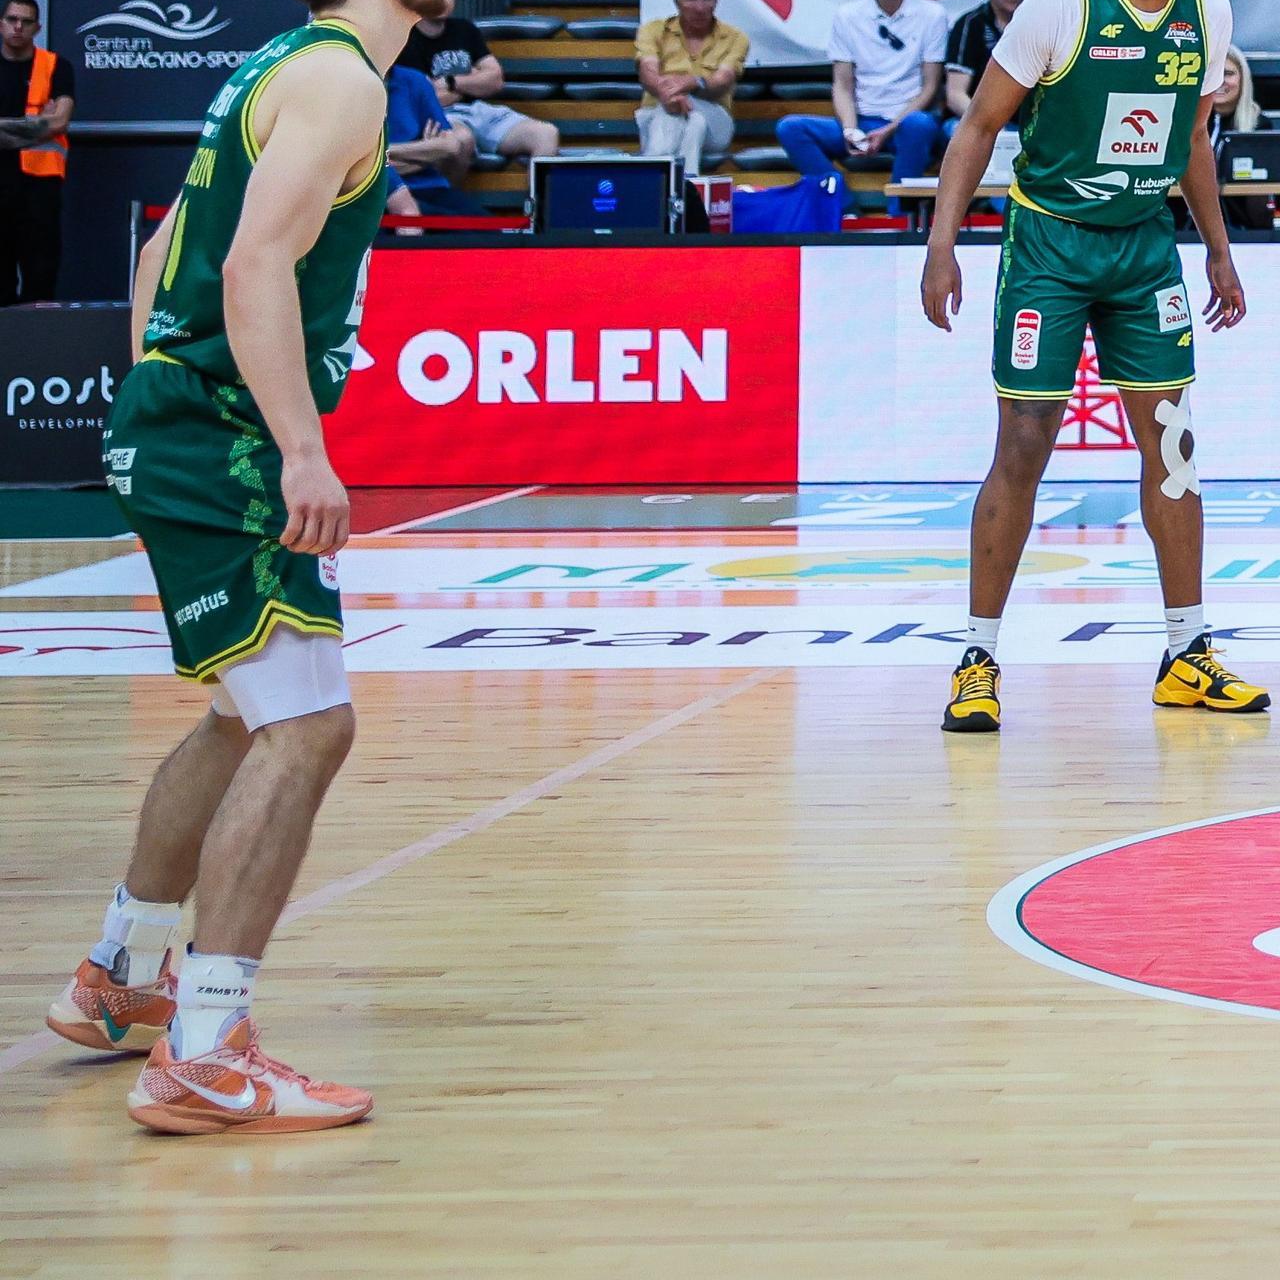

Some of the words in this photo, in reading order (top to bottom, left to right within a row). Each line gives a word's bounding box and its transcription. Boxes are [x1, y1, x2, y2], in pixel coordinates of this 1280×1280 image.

[1100, 24, 1125, 39] 4F
[84, 34, 153, 52] Centrum
[1092, 48, 1117, 57] ORLEN
[1154, 51, 1202, 86] 32
[1111, 142, 1159, 154] ORLEN
[1165, 313, 1189, 324] ORLEN
[397, 327, 729, 406] ORLEN
[6, 365, 114, 416] post
[18, 418, 105, 430] DEVELOPME
[425, 622, 970, 650] Bank
